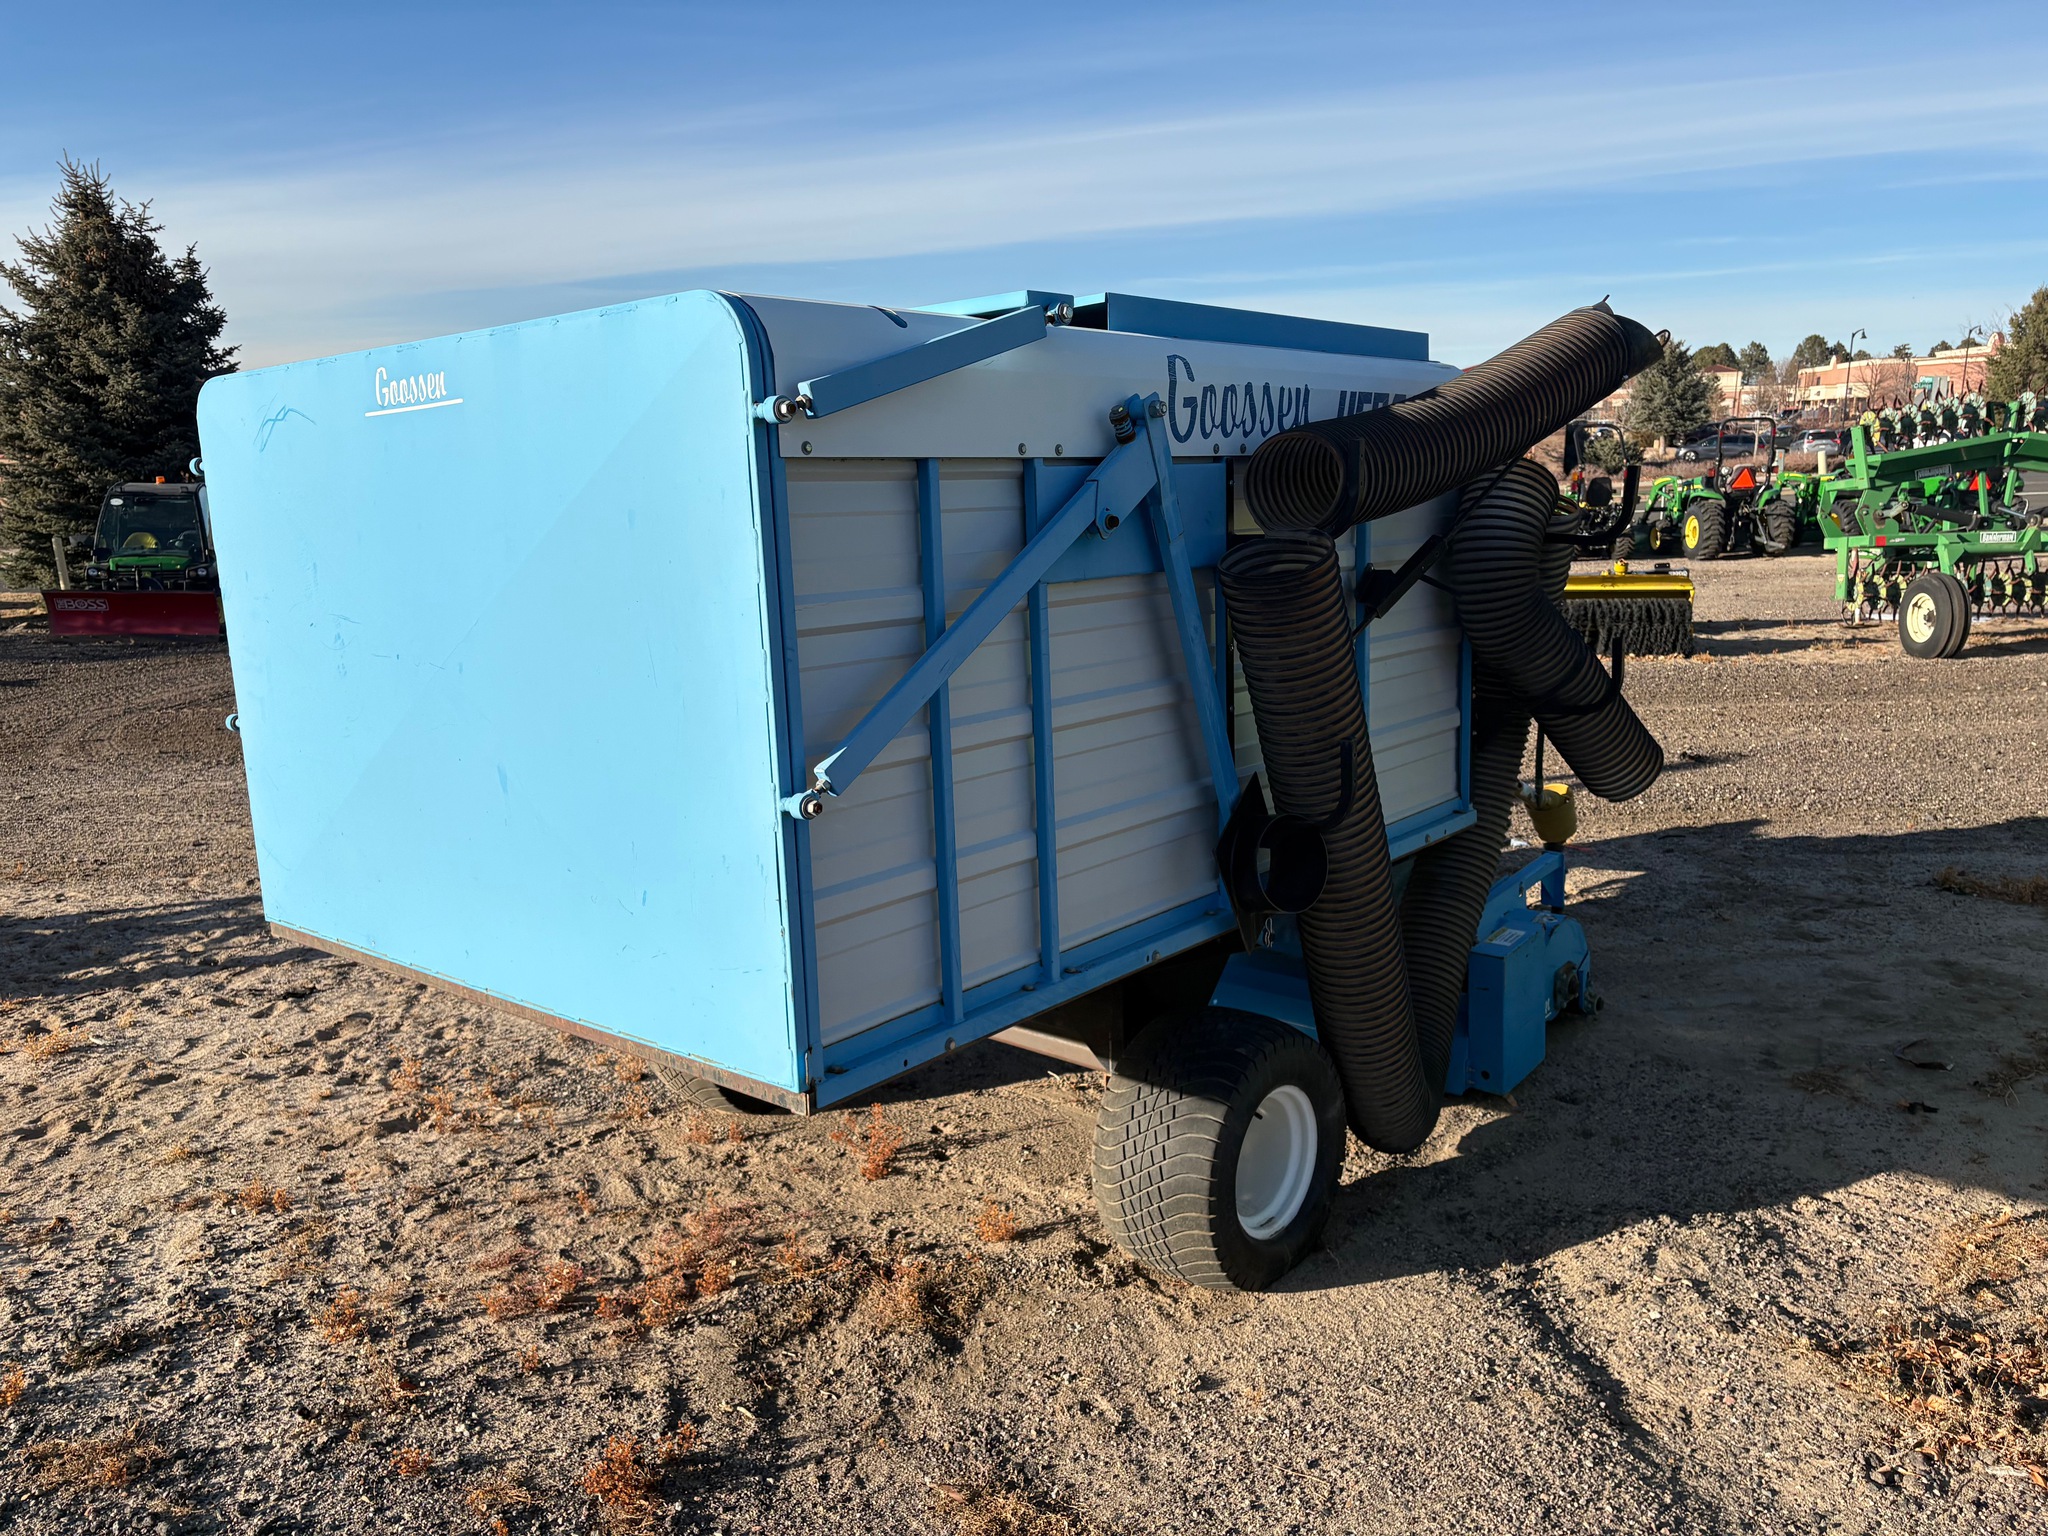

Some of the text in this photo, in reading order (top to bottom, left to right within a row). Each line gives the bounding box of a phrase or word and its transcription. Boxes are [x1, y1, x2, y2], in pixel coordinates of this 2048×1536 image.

[375, 366, 447, 407] Goossen
[1166, 353, 1311, 444] Goossen
[65, 599, 107, 610] BOSS
